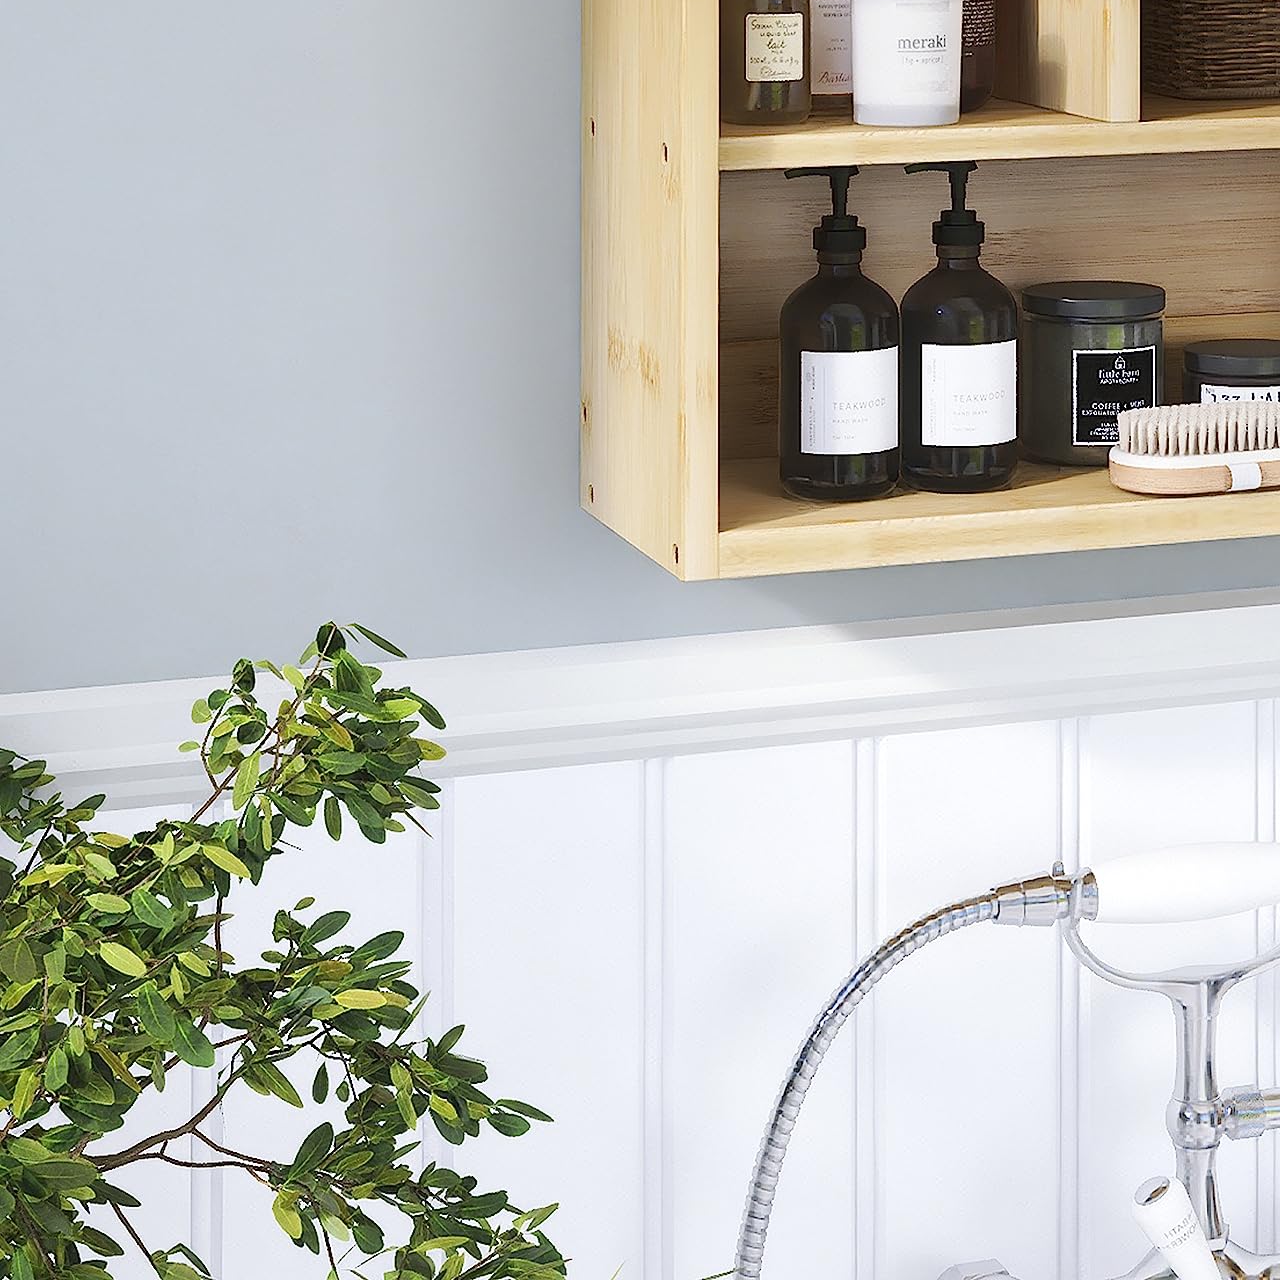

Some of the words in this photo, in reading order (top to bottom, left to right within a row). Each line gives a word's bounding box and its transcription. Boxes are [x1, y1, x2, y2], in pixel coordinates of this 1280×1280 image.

[897, 34, 947, 50] meraki
[952, 389, 1006, 403] TEAKWOOD
[832, 397, 887, 411] TEAKWOOD
[1091, 402, 1121, 411] COFFEE
